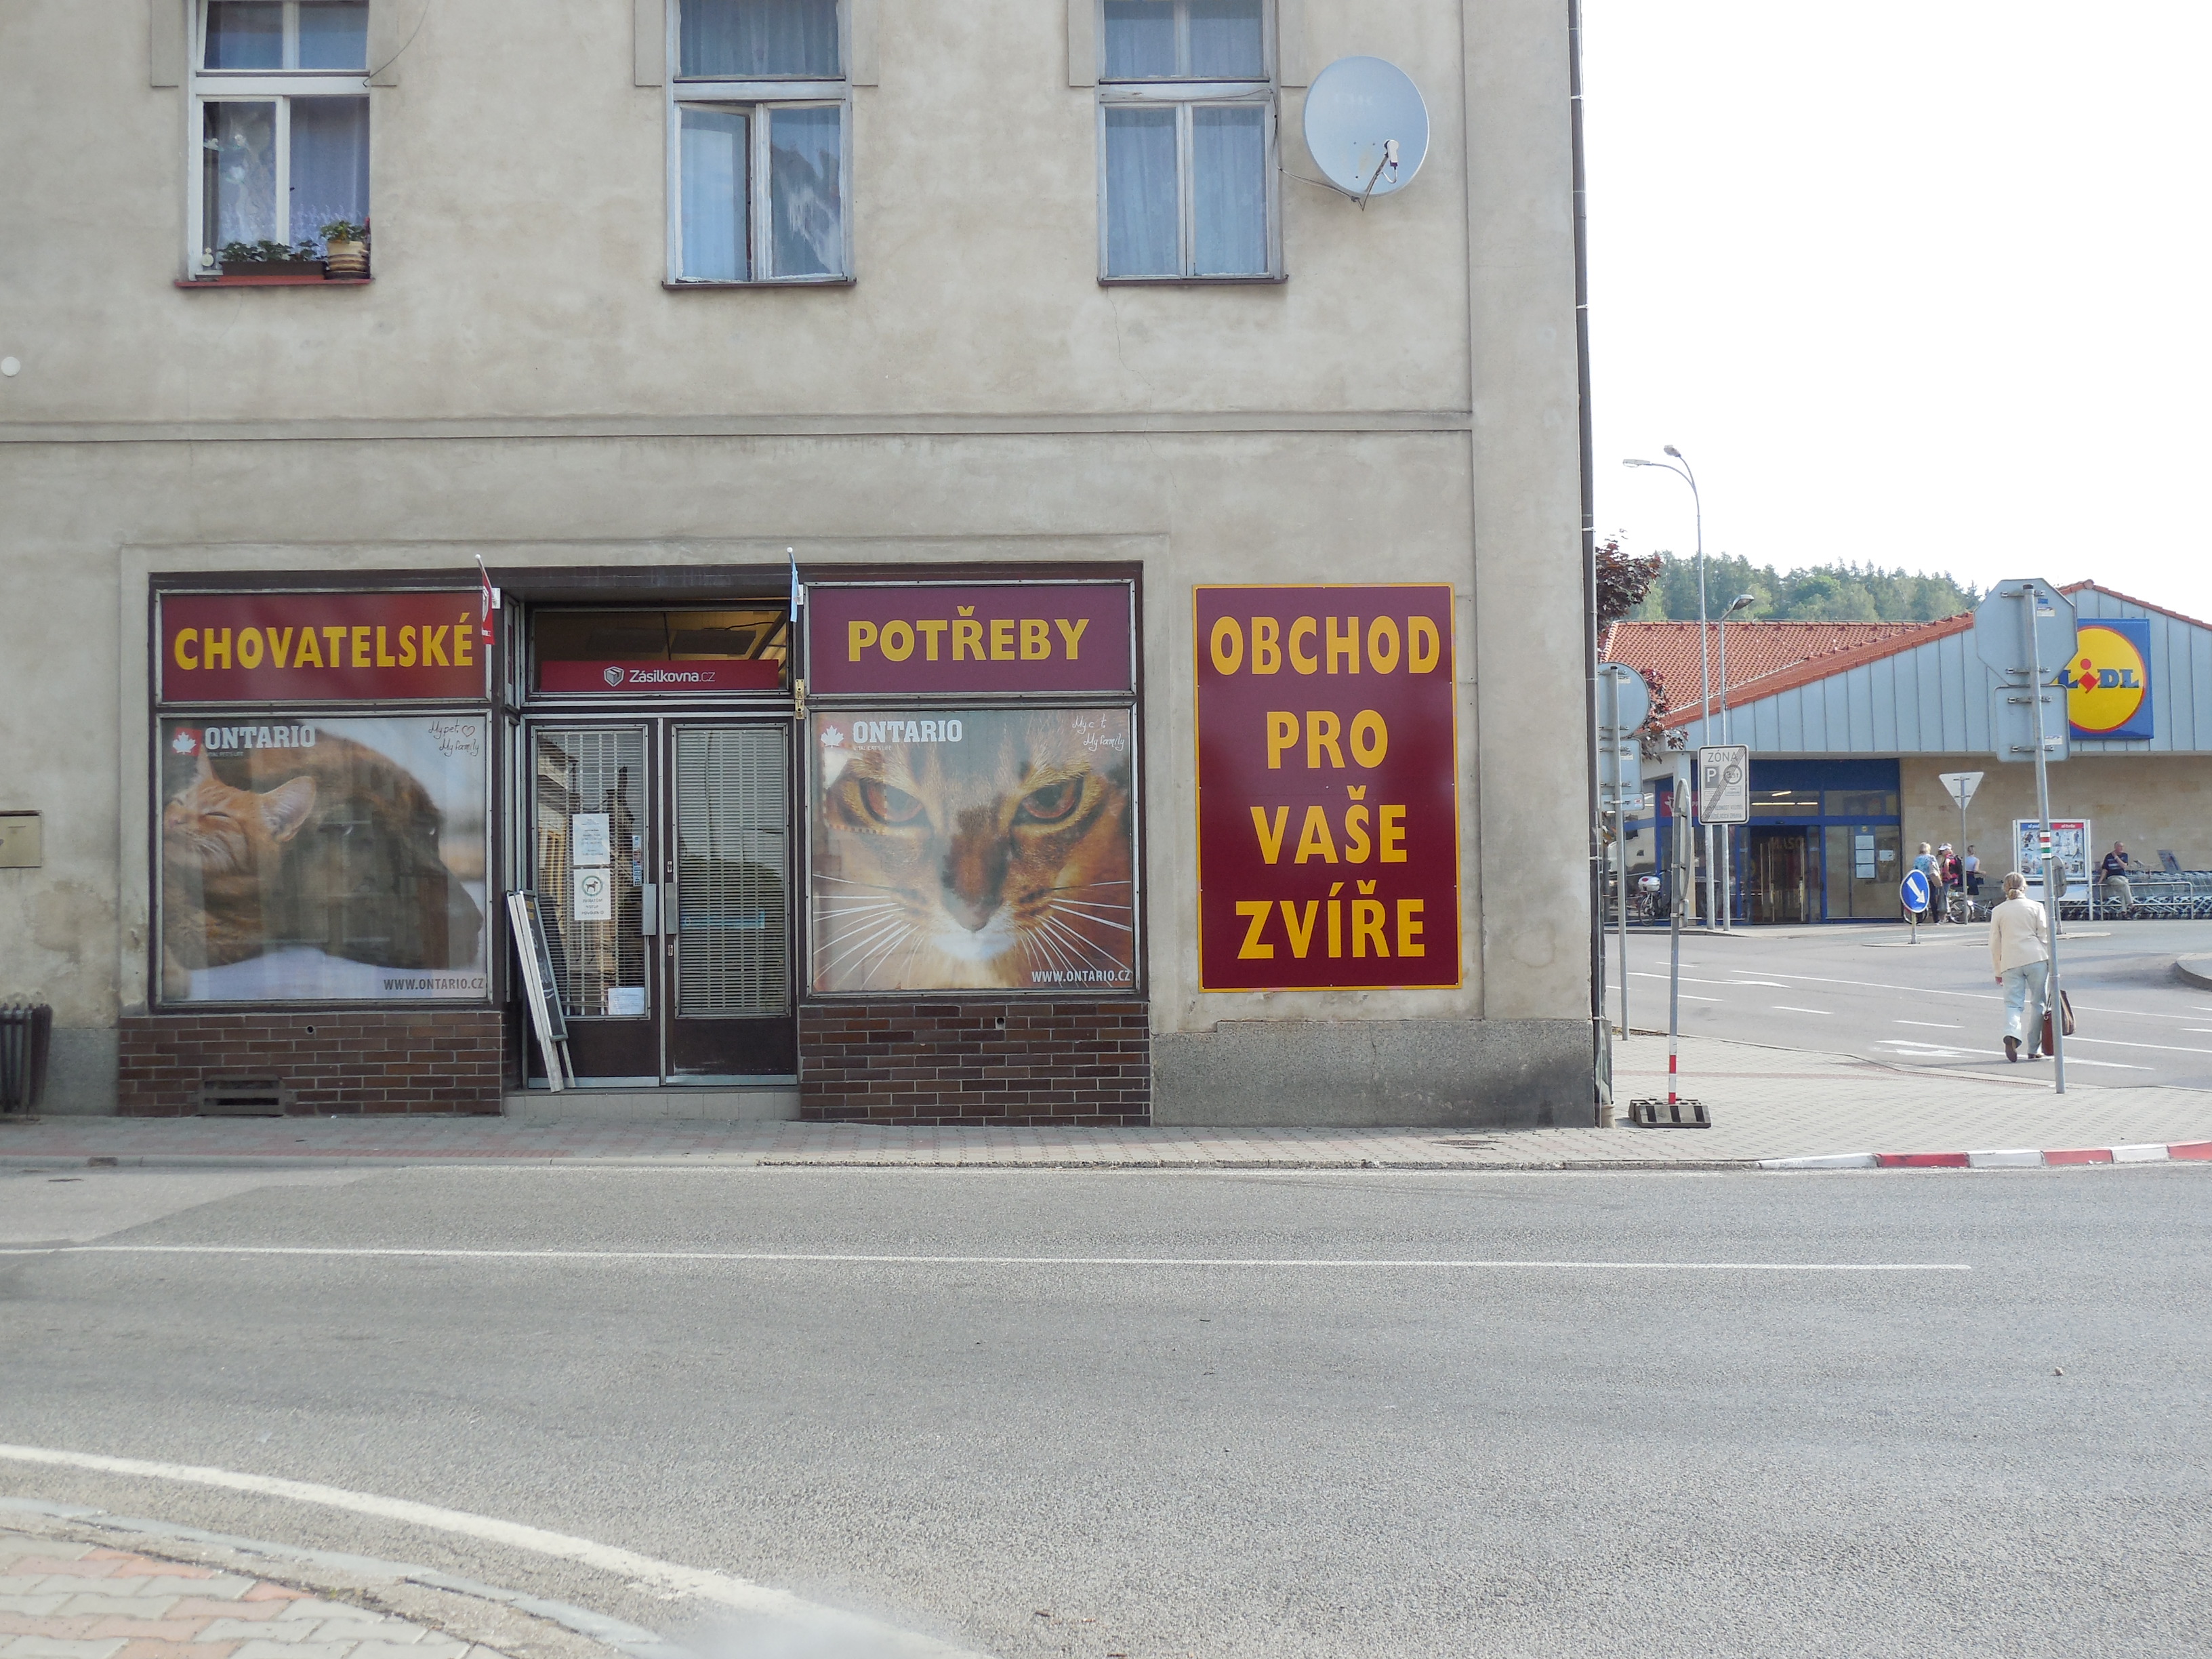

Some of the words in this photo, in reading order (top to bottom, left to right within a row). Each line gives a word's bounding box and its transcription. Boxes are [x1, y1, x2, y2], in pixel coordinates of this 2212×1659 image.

[173, 613, 473, 671] CHOVATELSKÉ
[848, 605, 1090, 663] POTŘEBY
[1210, 615, 1440, 676] OBCHOD
[428, 720, 443, 740] My
[853, 720, 962, 743] ONTARIO
[1072, 715, 1087, 735] My
[205, 725, 316, 750] ONTARIO
[439, 738, 454, 758] My
[455, 738, 479, 757] family
[1083, 733, 1099, 752] My
[1099, 733, 1125, 752] family
[1267, 709, 1388, 769] PRO
[1708, 750, 1738, 762] ZÓNA
[1706, 768, 1717, 783] P
[1250, 785, 1408, 865] VAŠE
[1235, 879, 1425, 960] ZVÍŘE
[384, 978, 485, 990] WWW.ONTARIO.CZ
[1031, 969, 1131, 983] WWW.ONTARIO.CZ
